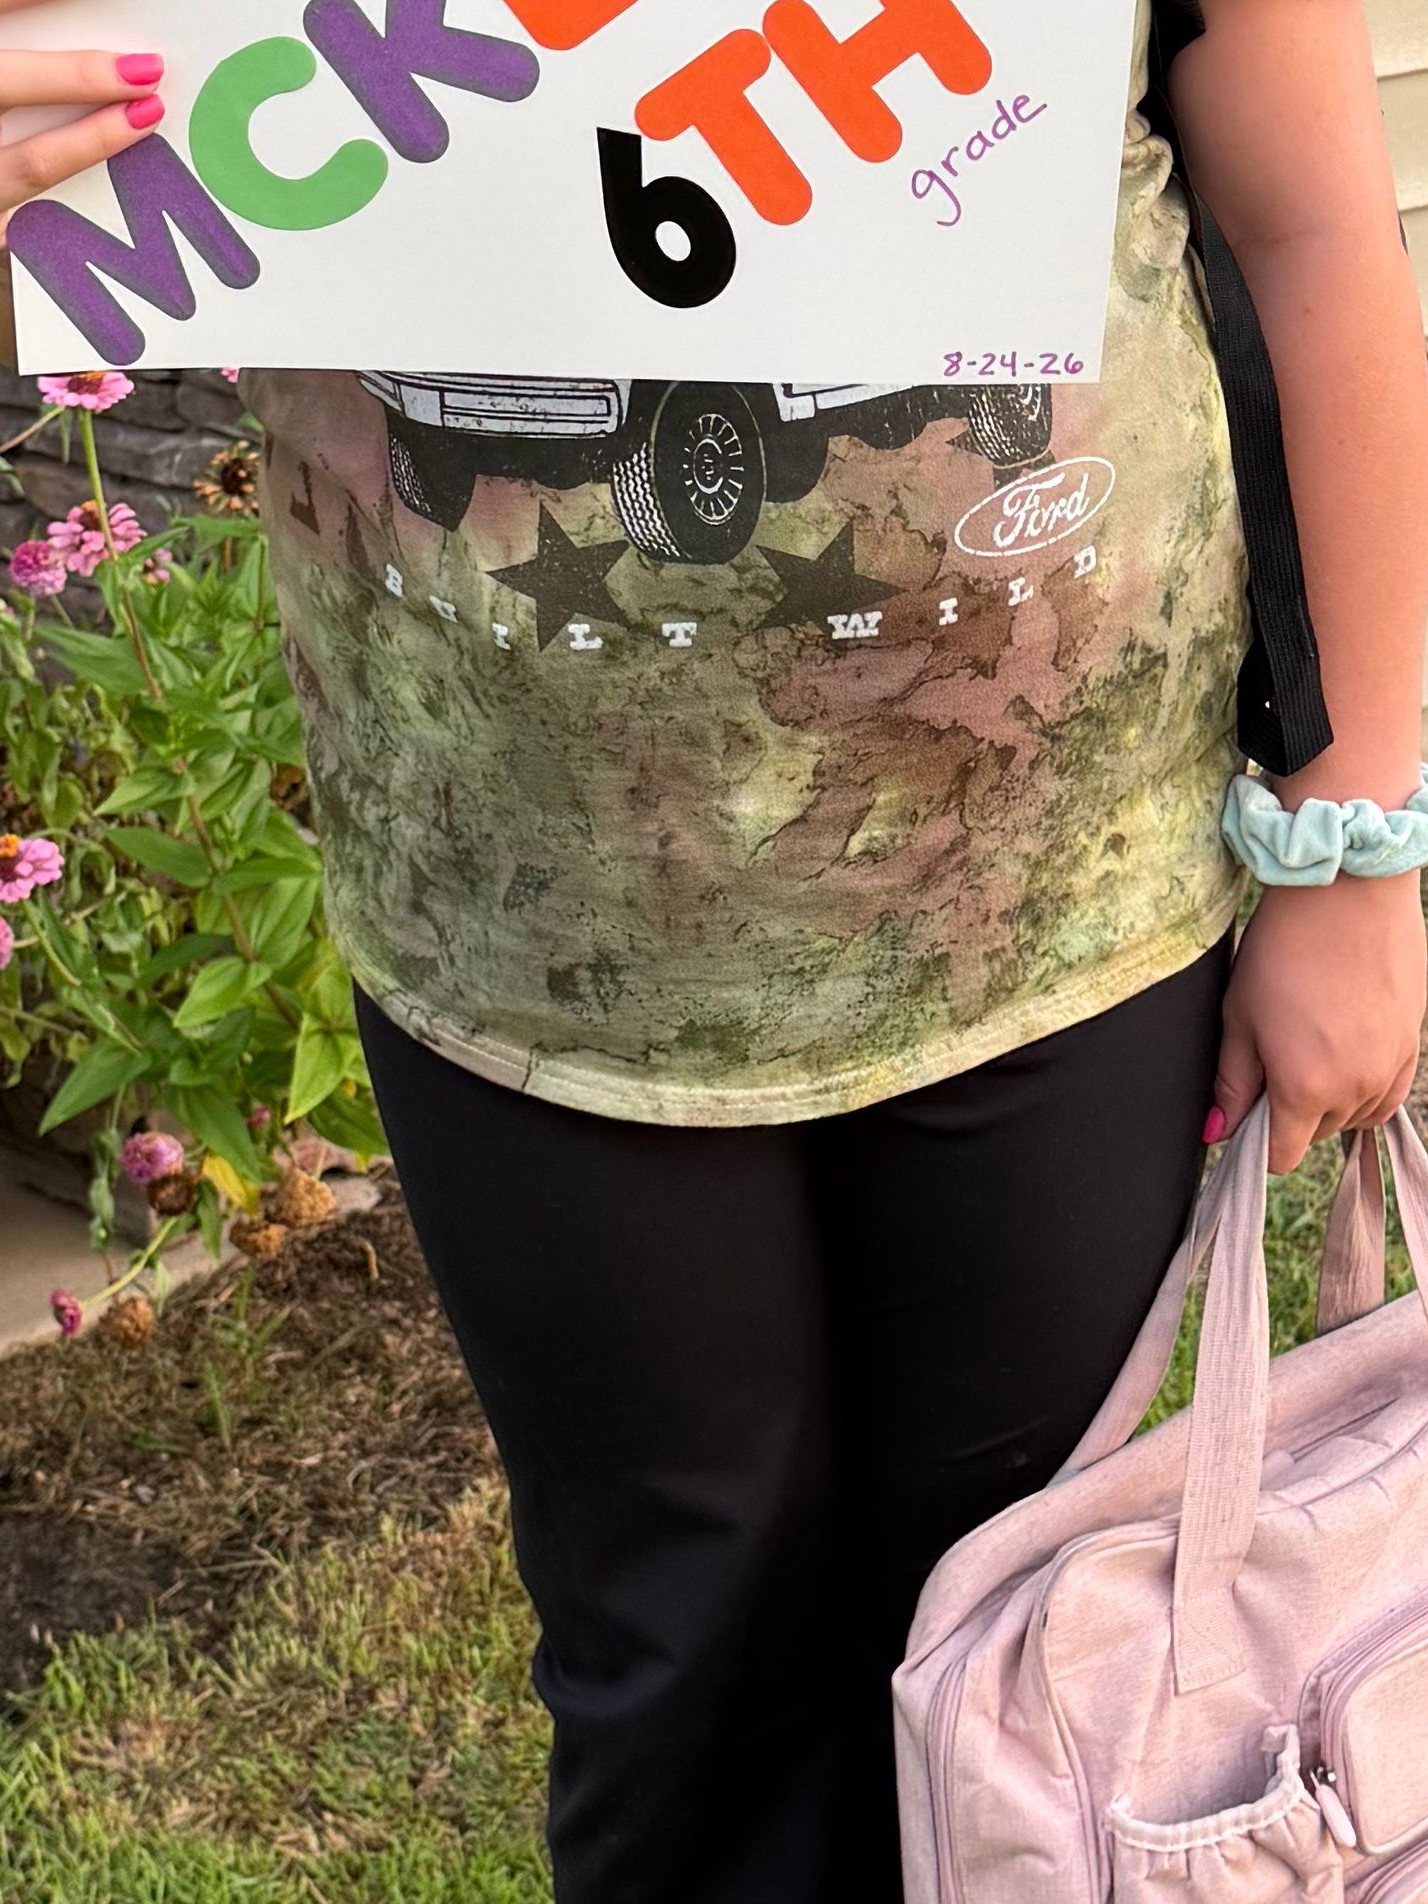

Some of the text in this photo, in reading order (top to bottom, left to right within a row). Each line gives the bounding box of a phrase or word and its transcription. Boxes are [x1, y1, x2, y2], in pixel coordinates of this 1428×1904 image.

[911, 94, 1048, 227] grade
[942, 351, 1085, 377] 8-24-26
[992, 471, 1090, 547] Ford
[826, 545, 1097, 640] WILD
